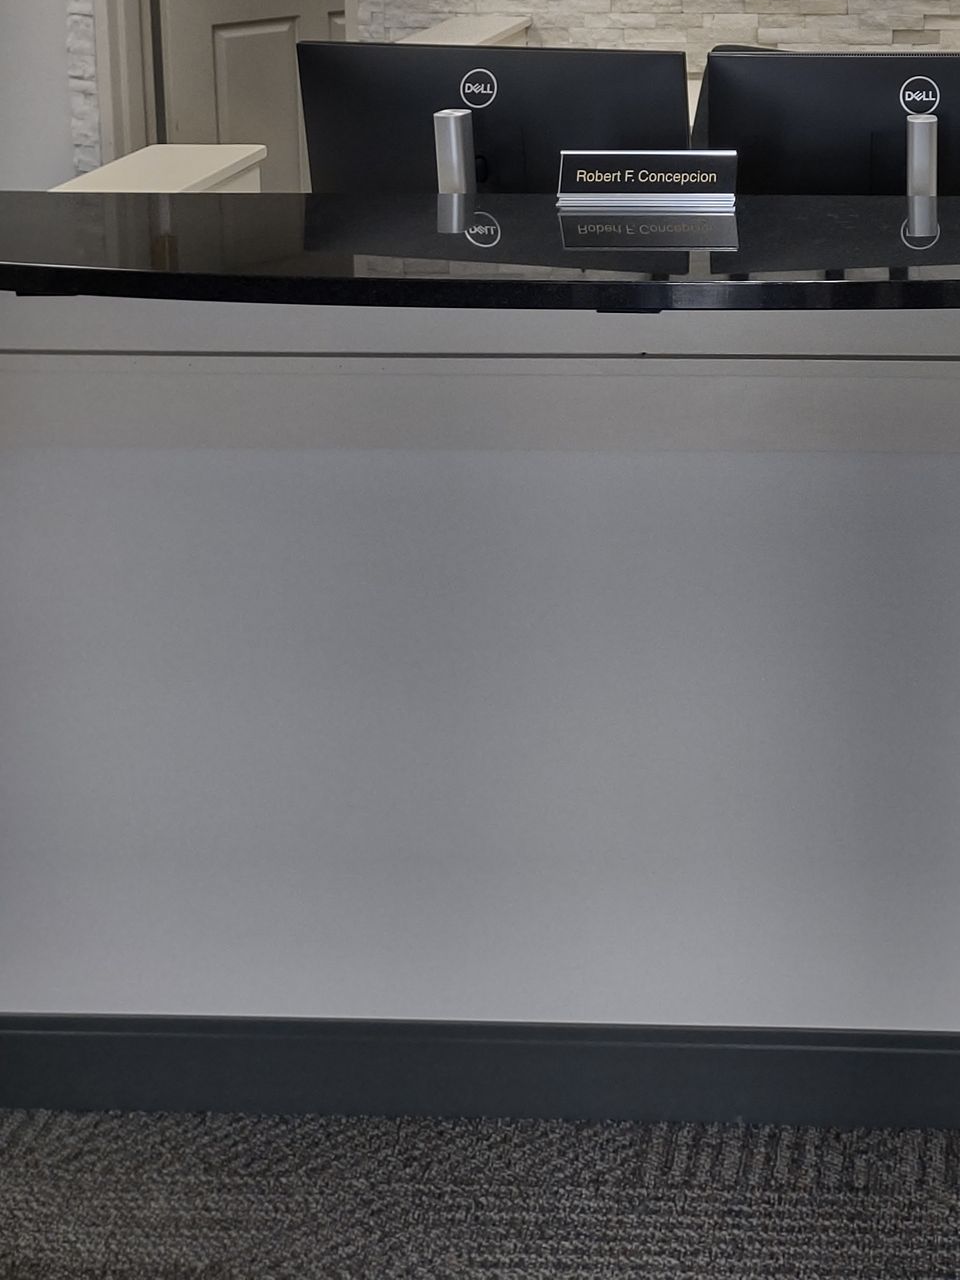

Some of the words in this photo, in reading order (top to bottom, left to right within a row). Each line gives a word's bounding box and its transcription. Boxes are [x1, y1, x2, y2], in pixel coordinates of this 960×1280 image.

[464, 82, 494, 94] DELL
[904, 90, 936, 101] DELL
[576, 169, 622, 183] Robert
[624, 170, 635, 183] F.
[638, 169, 717, 185] Concepcion
